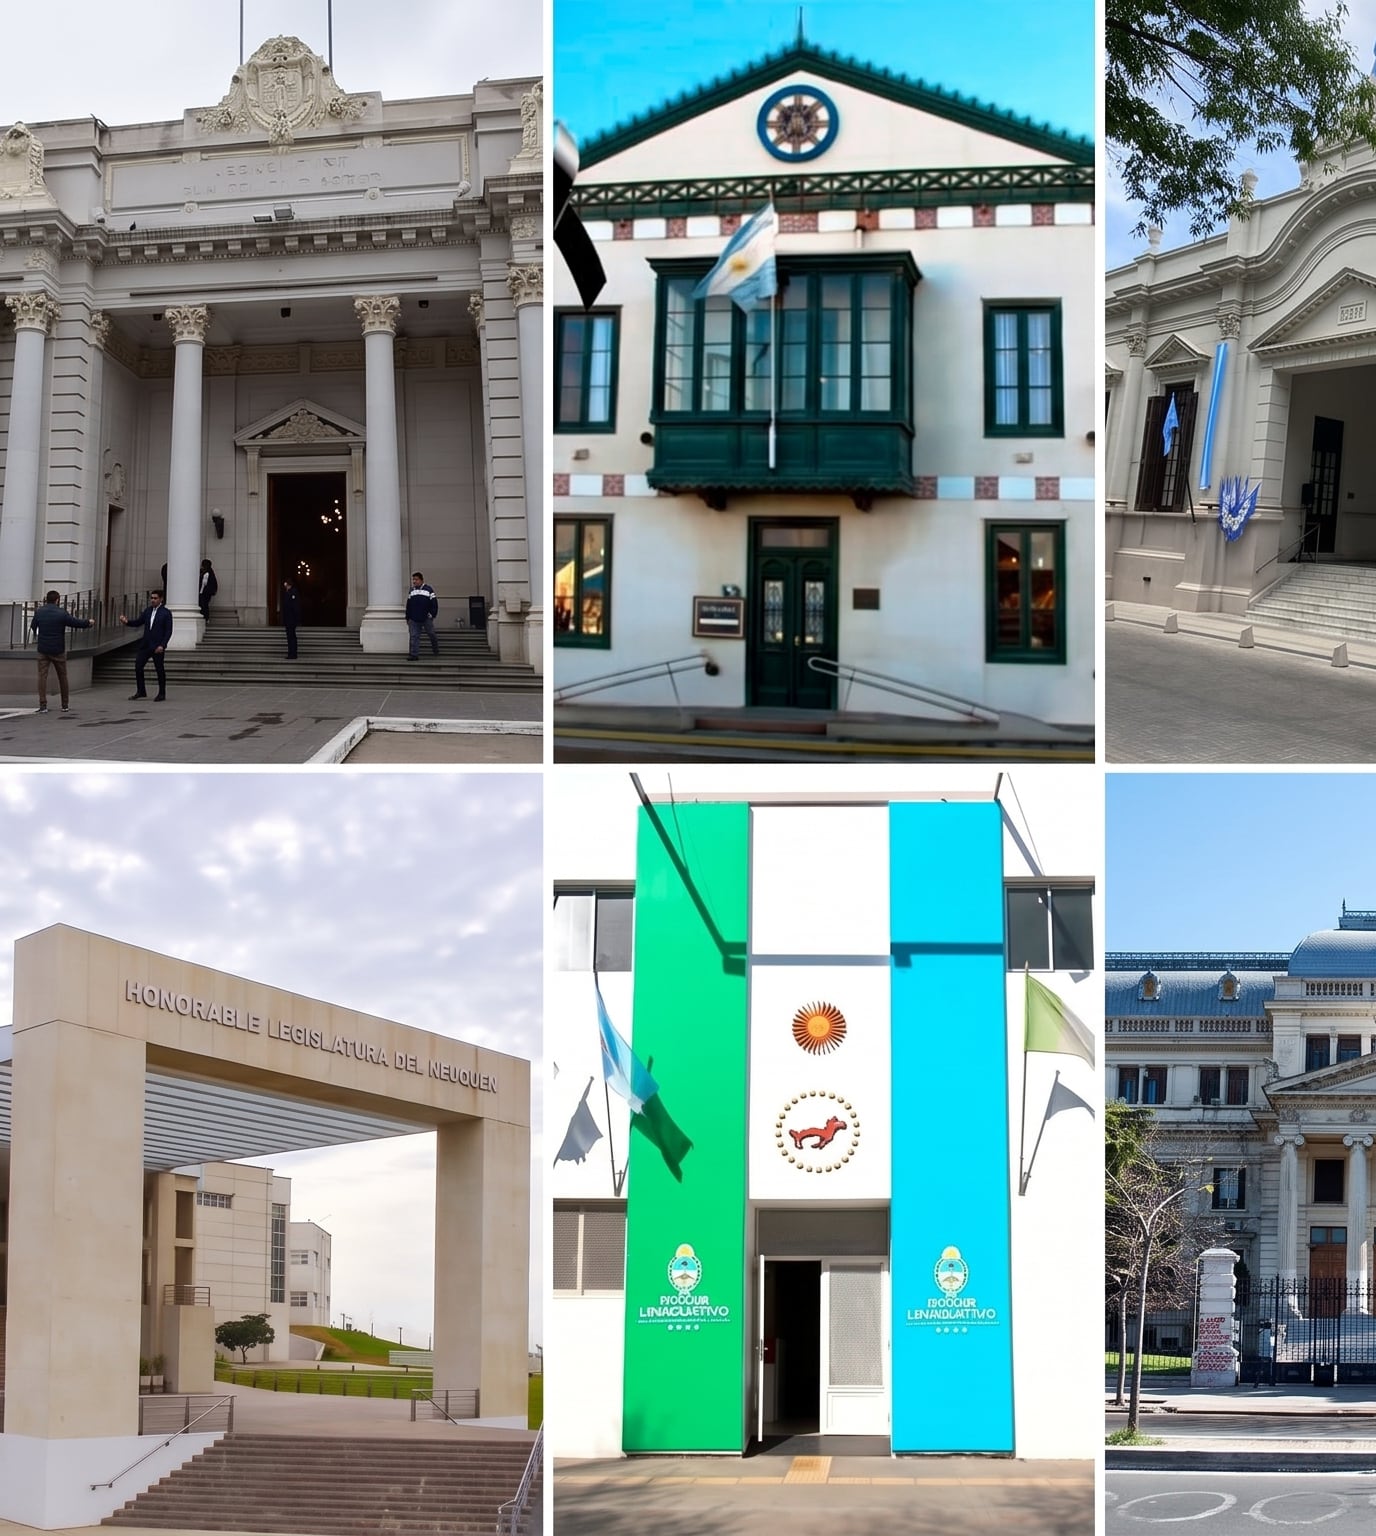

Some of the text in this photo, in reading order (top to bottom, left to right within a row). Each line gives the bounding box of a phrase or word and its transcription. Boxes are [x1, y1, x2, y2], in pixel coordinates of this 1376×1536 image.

[125, 979, 498, 1094] HONORABLE LEGISLATURA DEL NEUQUEN
